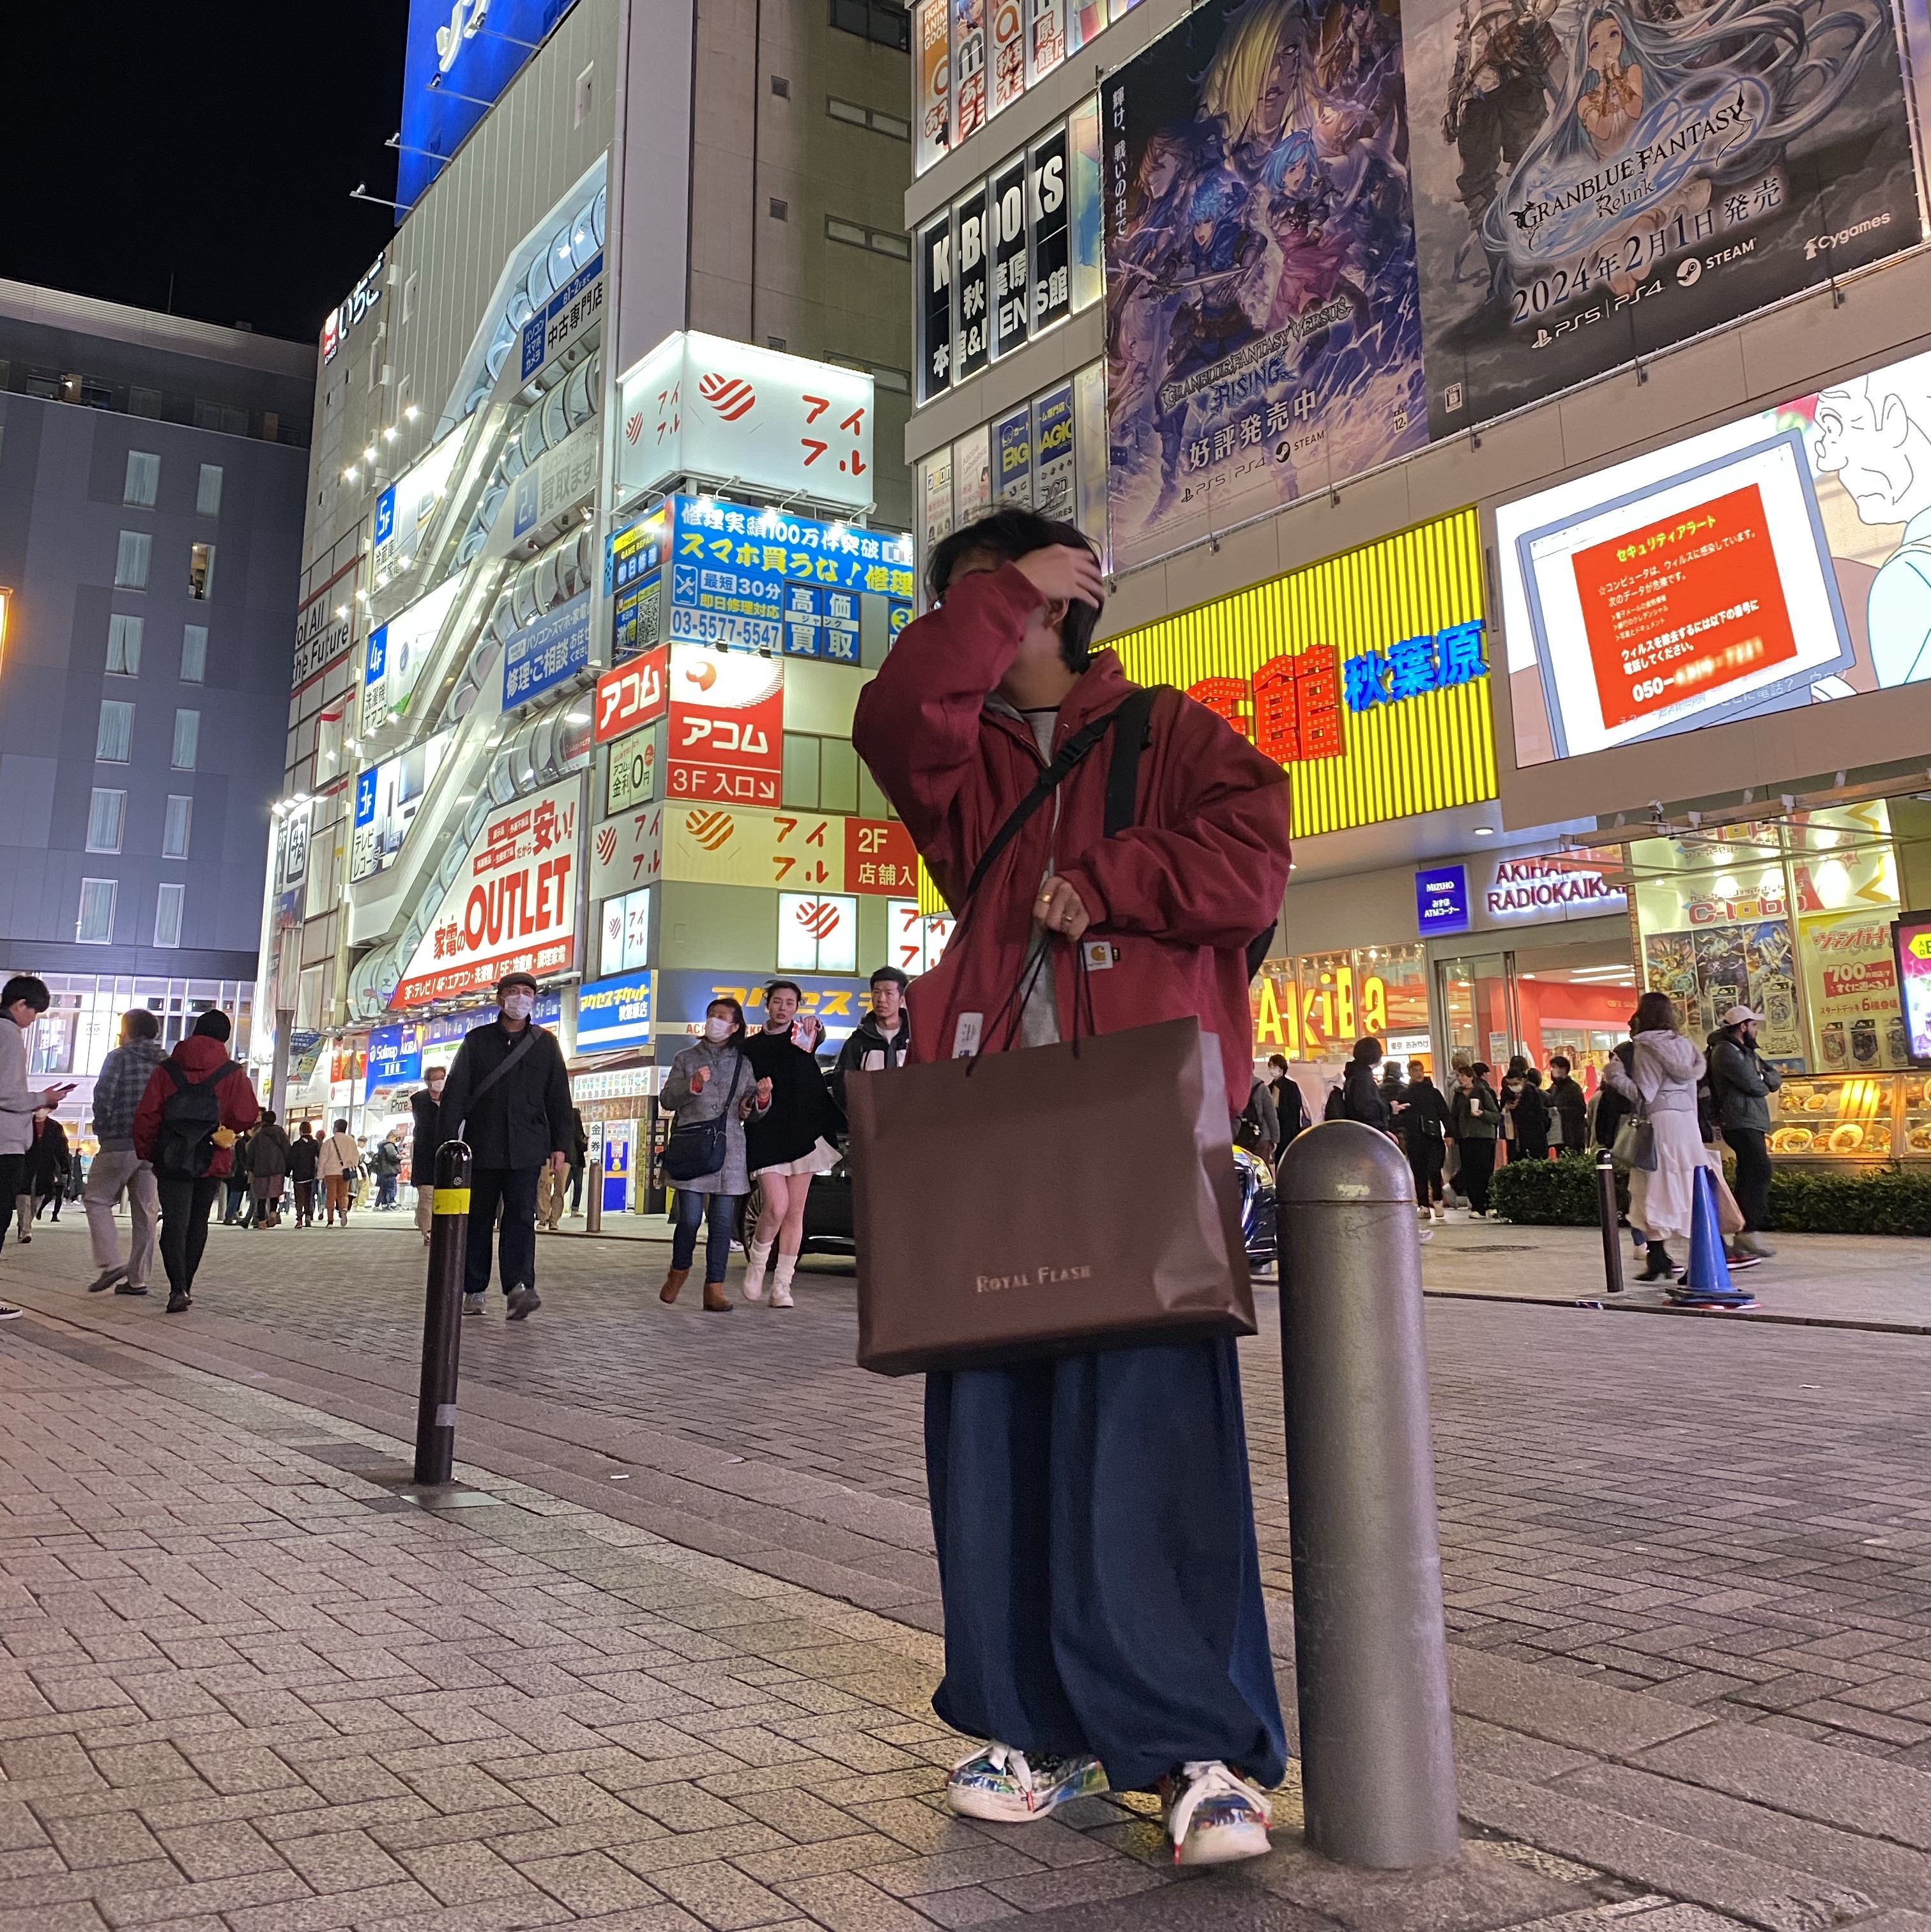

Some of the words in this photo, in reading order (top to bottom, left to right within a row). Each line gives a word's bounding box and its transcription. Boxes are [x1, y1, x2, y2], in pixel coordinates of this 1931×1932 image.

[1113, 86, 1127, 235] 輝け、戦いの中で
[1509, 157, 1635, 249] GRANBLUE
[1635, 88, 1754, 166] FANTASY
[1596, 177, 1657, 218] Relink
[1512, 209, 1714, 325] 2024年2月1日
[1723, 177, 1783, 227] 発売
[1555, 307, 1601, 339] PS5
[1614, 279, 1665, 313] PS4
[1706, 237, 1756, 271] STEAM
[1818, 211, 1891, 250] Cygames
[547, 281, 603, 349] 中古専門店
[524, 320, 543, 346] パソコン
[526, 335, 542, 357] スマホ
[525, 351, 541, 372] カメラ
[1161, 358, 1232, 411] GRANBLUE
[1230, 330, 1291, 376] FANTASY
[1288, 296, 1354, 343] VERSUS
[657, 381, 680, 415] アイ
[1209, 349, 1299, 420] RISING
[657, 419, 680, 446] フル
[802, 395, 865, 436] アイ
[1189, 388, 1317, 473] 好評発売中
[801, 438, 867, 476] フル
[1196, 473, 1225, 495] PS5
[1235, 456, 1266, 479] PS4
[1294, 430, 1325, 451] STEAM
[541, 452, 595, 516] 買取ます
[518, 485, 534, 525] 2F
[621, 546, 636, 560] GAME
[636, 533, 655, 551] REPAIR
[1615, 514, 1716, 562] セキュリティアラート
[618, 545, 657, 584] 即日修理
[703, 572, 734, 594] 最短
[738, 578, 781, 601] 30分
[791, 587, 852, 620] 高価
[308, 600, 325, 636] All
[699, 593, 781, 620] 即日修理対応
[802, 614, 843, 627] ジャンク
[310, 622, 349, 670] Future
[672, 608, 781, 652] 03-5577-5547
[790, 625, 853, 661] 買取
[370, 639, 383, 672] 4F
[1342, 618, 1490, 713] 秋葉原
[1623, 641, 1695, 675] 電話してください。
[600, 664, 660, 730] アコム
[682, 716, 768, 754] アコム
[613, 773, 629, 798] 金利
[632, 754, 650, 789] 0円
[673, 768, 707, 792] 3F
[712, 772, 755, 799] 入口
[359, 779, 372, 818] 3F
[355, 827, 375, 855] テレビ
[634, 809, 661, 843] アイ
[774, 816, 827, 848] アイ
[858, 827, 889, 854] 2F
[634, 849, 661, 881] フル
[772, 855, 829, 884] フル
[858, 862, 915, 887] 店舗入
[1426, 881, 1454, 893] MIZUHO
[1431, 898, 1451, 908] みずほ
[433, 921, 466, 961] 家電の
[464, 854, 572, 951] OUTLET
[629, 908, 645, 928] アイ
[1424, 907, 1460, 918] ATMコーナー
[628, 931, 644, 949] フル
[1827, 962, 1866, 983] 700
[579, 984, 650, 1013] アクセスチケット
[376, 1045, 398, 1061] Sofmap
[399, 1040, 418, 1055] AKIBA
[1405, 1039, 1429, 1050] おみやげ
